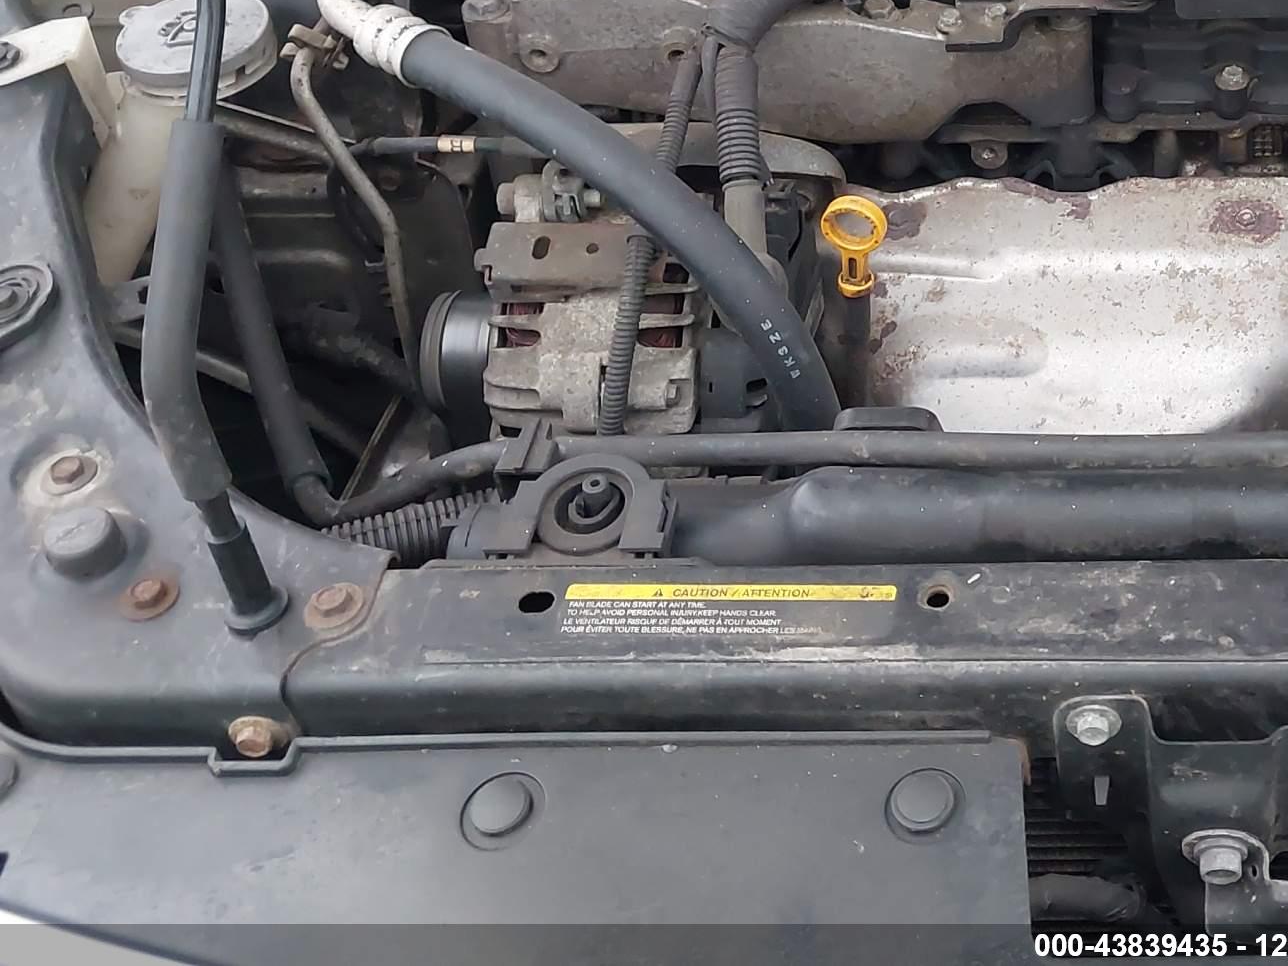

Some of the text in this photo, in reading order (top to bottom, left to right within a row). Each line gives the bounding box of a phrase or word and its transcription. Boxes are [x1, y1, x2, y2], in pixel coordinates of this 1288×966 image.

[672, 588, 728, 597] CAUTION
[742, 589, 810, 598] ATTENTION
[671, 617, 715, 625] DÉMARRER
[586, 625, 612, 633] ÉVITER
